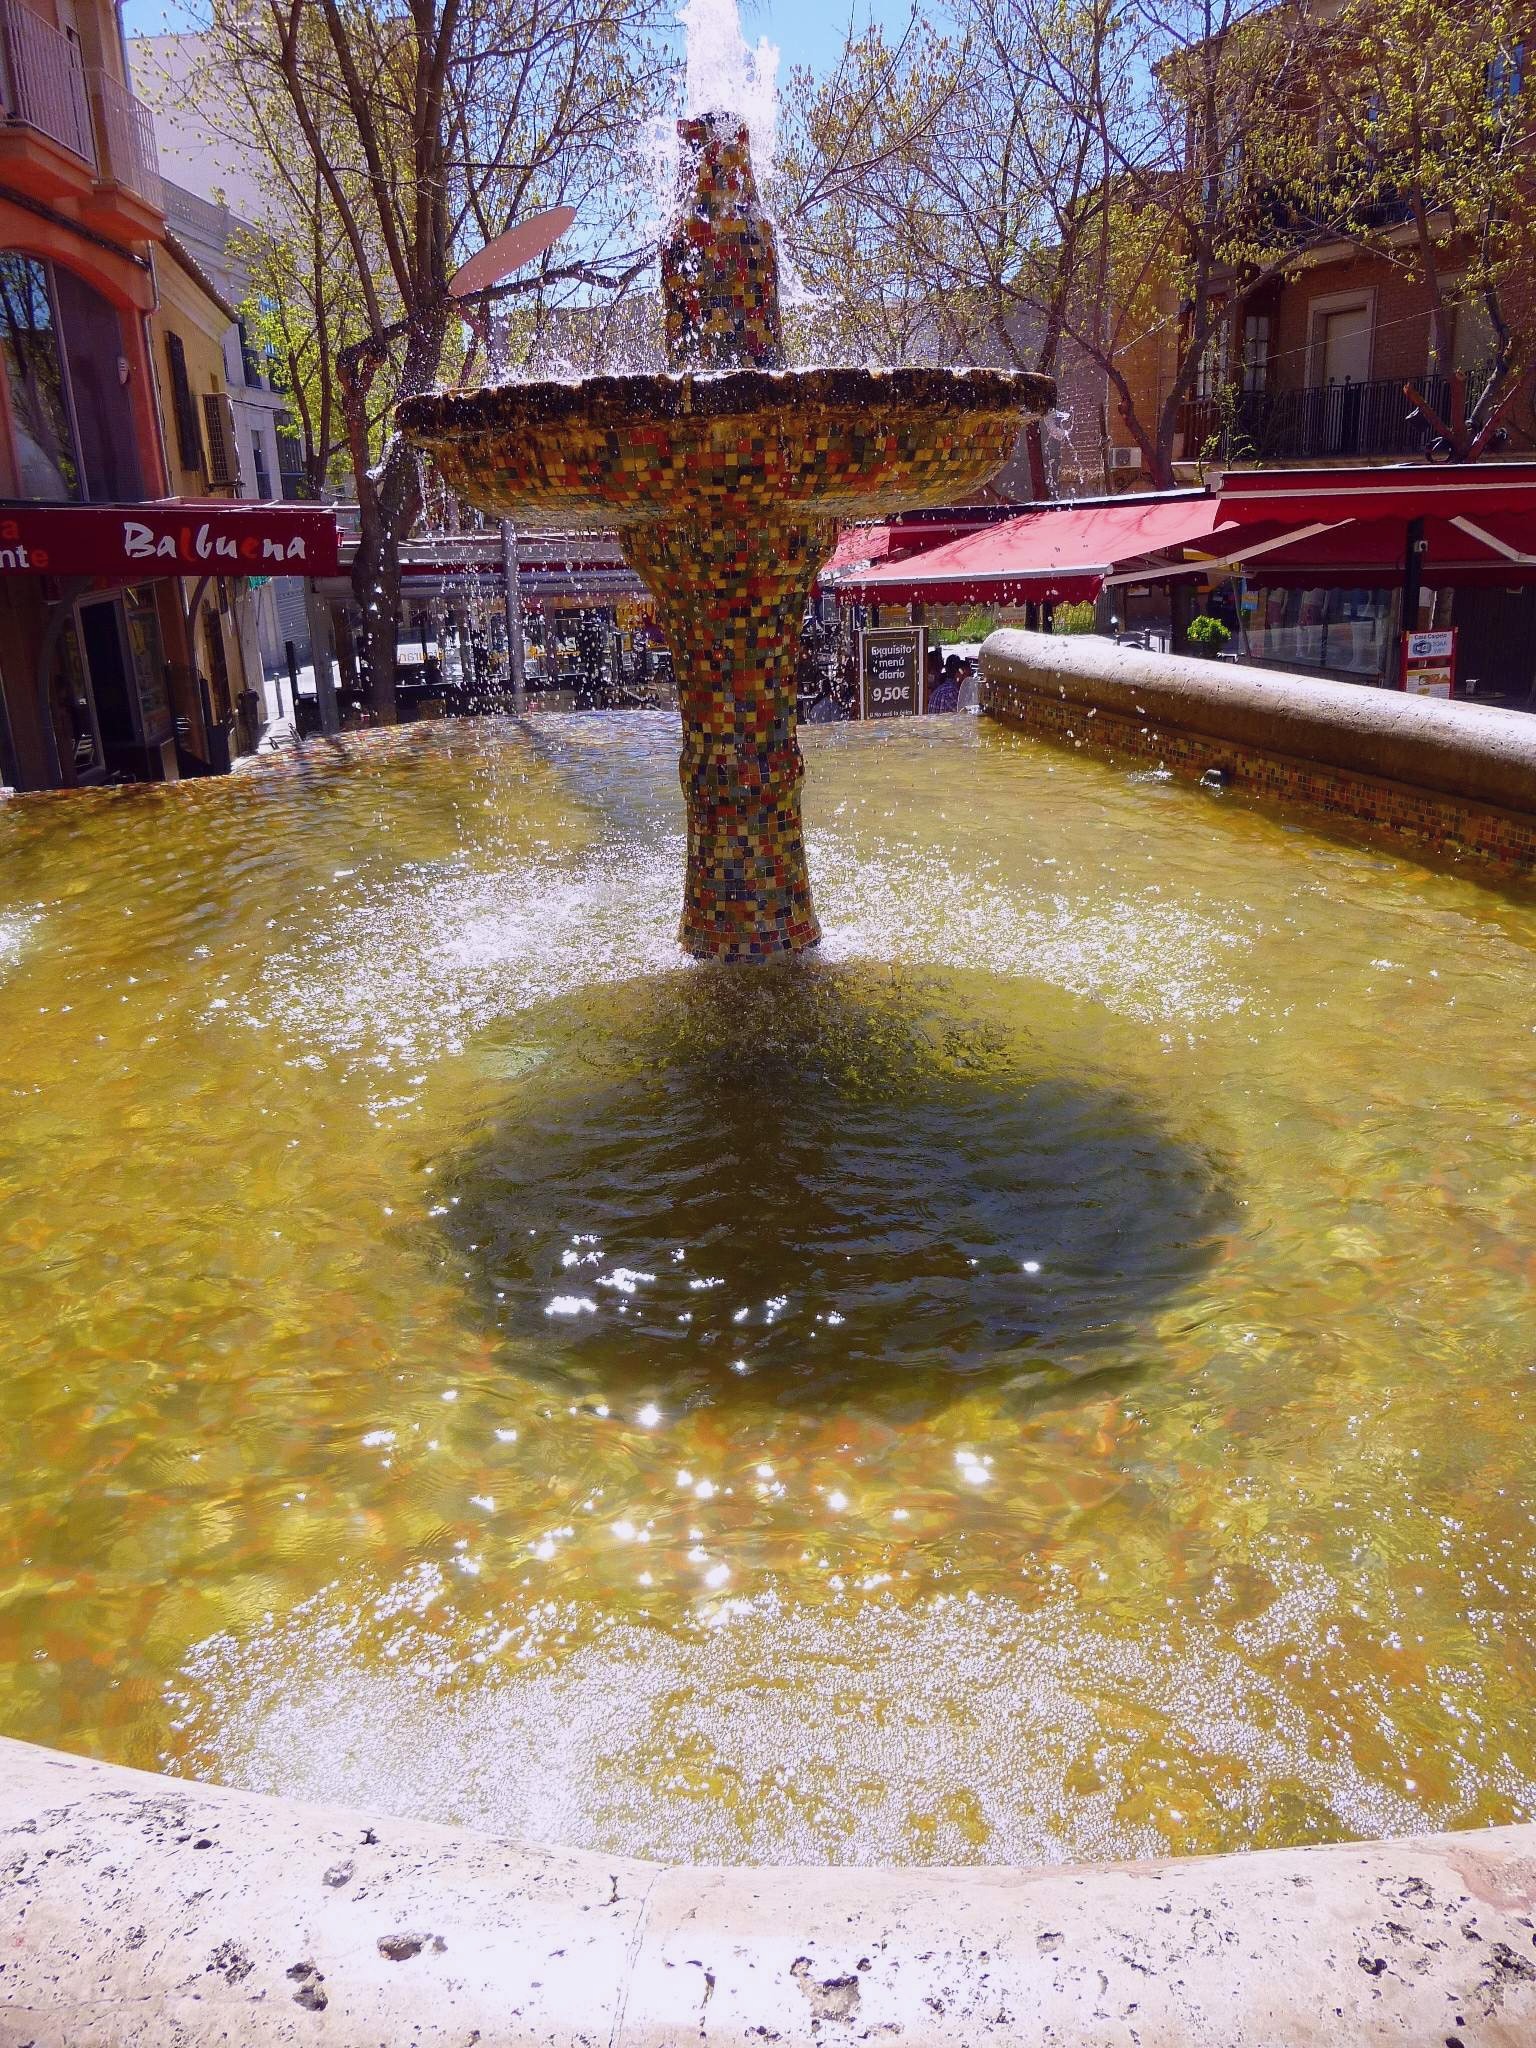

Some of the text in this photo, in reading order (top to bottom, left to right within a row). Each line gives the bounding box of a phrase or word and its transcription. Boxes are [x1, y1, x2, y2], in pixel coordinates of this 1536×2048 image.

[123, 521, 306, 562] Balbuena
[871, 644, 912, 656] Exquisito
[878, 657, 905, 667] menú
[878, 669, 905, 680] diario
[873, 686, 910, 703] 9,50€
